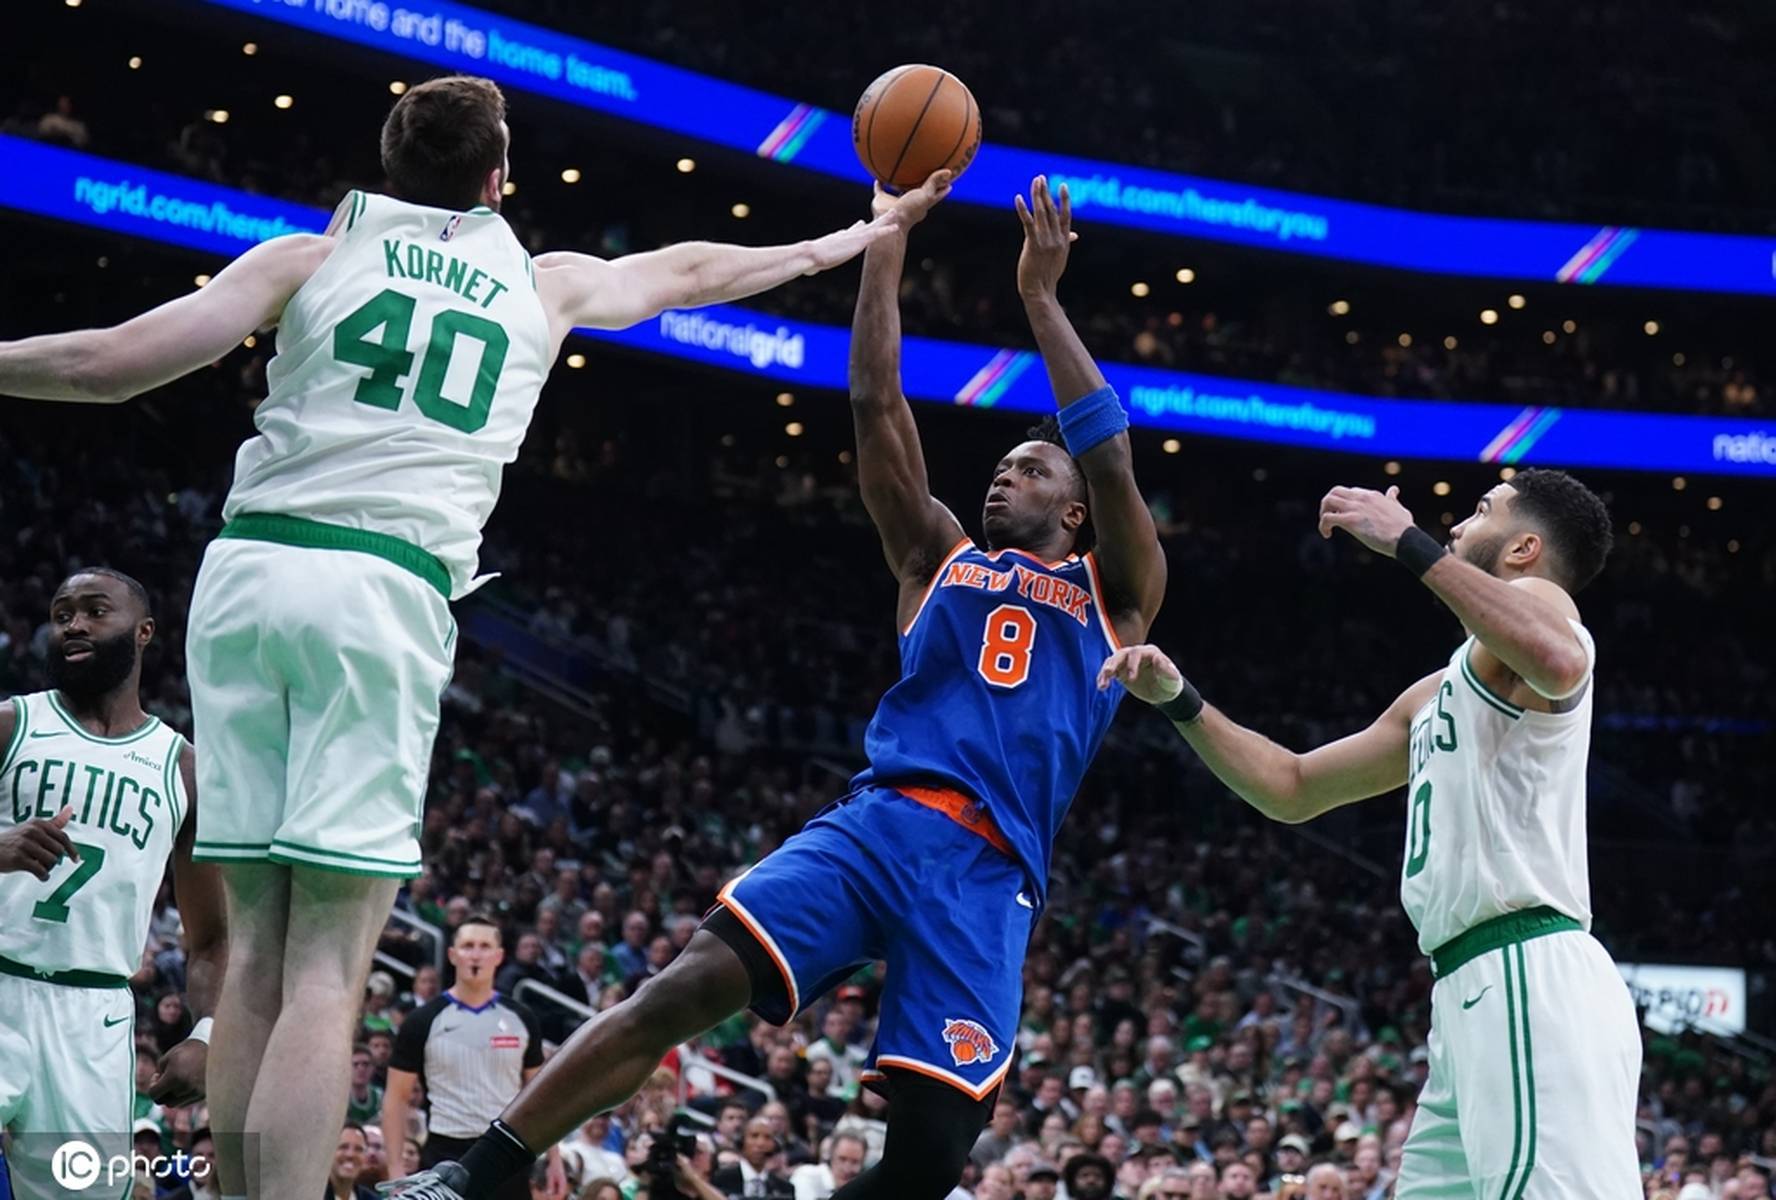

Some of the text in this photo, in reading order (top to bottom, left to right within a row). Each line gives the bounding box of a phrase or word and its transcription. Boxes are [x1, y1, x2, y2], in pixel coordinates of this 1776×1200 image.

[391, 8, 443, 46] and
[445, 18, 486, 59] the
[488, 29, 563, 81] home
[383, 239, 509, 309] KORNET
[333, 288, 511, 435] 40
[940, 561, 1092, 628] NEW YORK
[977, 603, 1037, 688] 8
[12, 758, 162, 851] CELTICS
[1405, 779, 1433, 879] 0
[32, 840, 106, 924] 7
